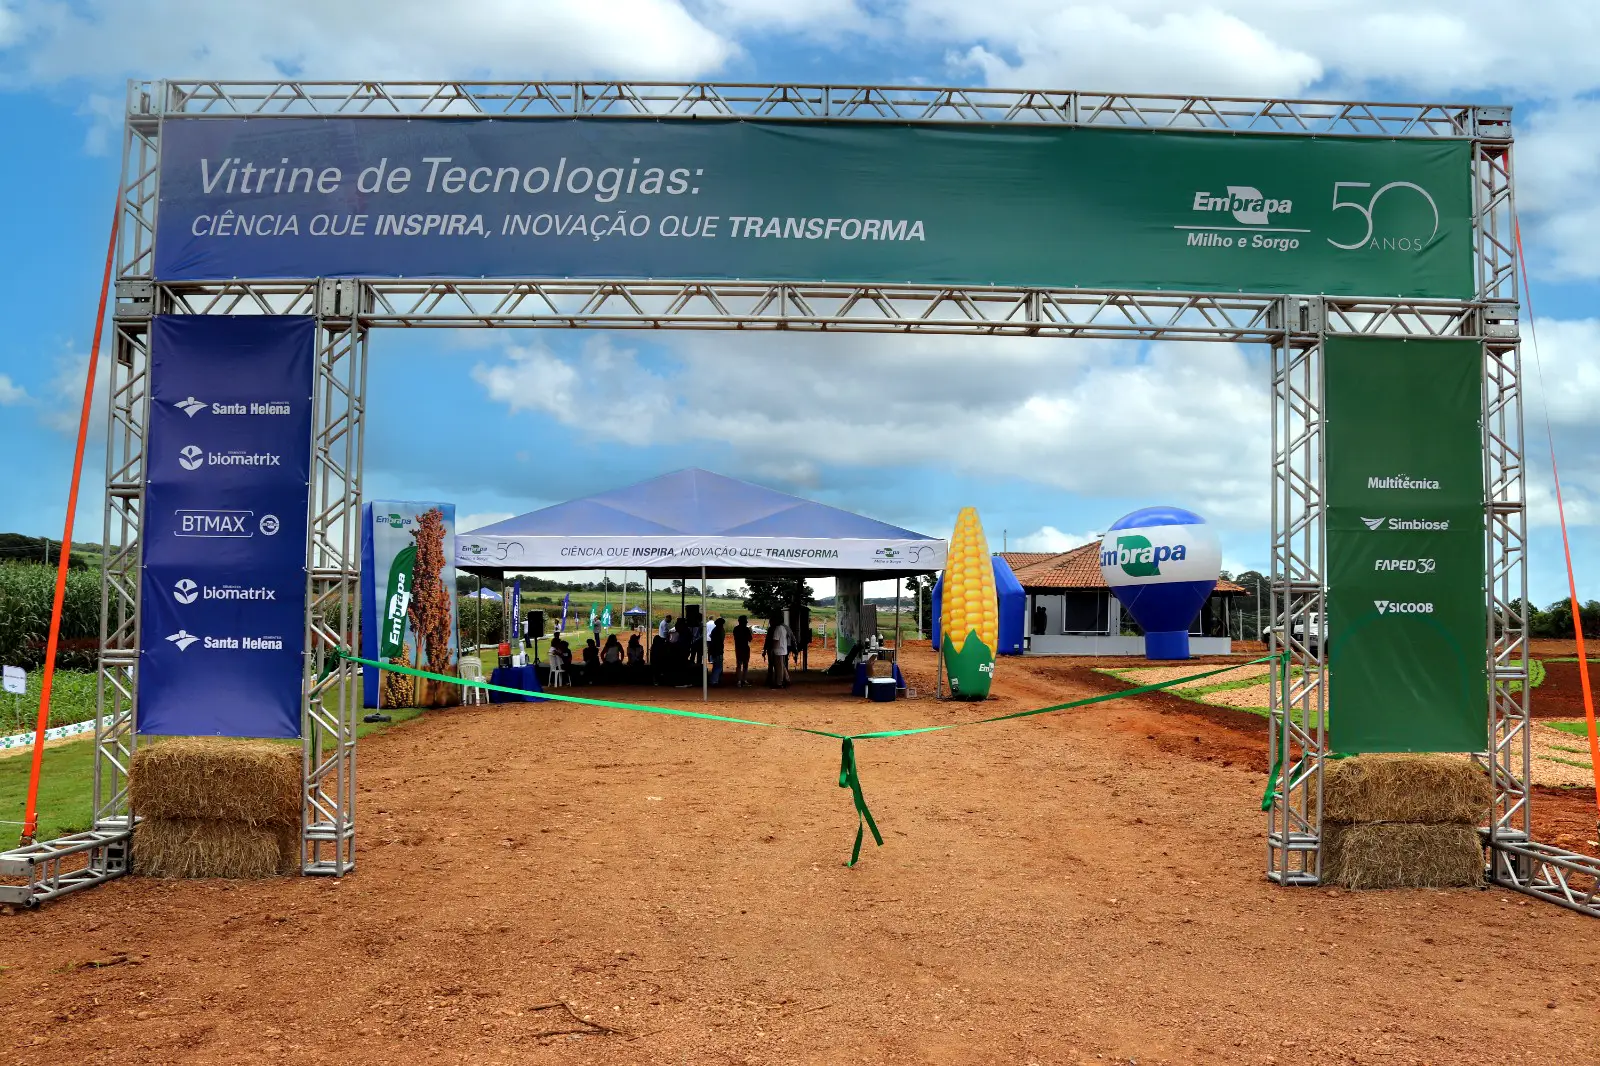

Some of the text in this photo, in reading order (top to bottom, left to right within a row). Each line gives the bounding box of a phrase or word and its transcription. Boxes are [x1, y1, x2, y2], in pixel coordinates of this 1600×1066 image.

[200, 157, 704, 203] Vitrine de Tecnologias:
[1193, 190, 1293, 214] Embrapa
[1327, 181, 1439, 250] 50
[191, 209, 926, 242] CIÊNCIA QUE INSPIRA, INOVAÇÃO QUE TRANSFORMA
[1186, 232, 1300, 252] Milho e Sorgo
[1369, 236, 1423, 251] ANOS
[212, 402, 291, 415] Santa Helena
[208, 452, 281, 466] biomatrix
[182, 514, 246, 532] BTMAX
[560, 545, 603, 557] CIÊNCIA
[607, 547, 630, 557] QUE
[680, 546, 738, 558] INOVAÇÃO
[740, 547, 763, 558] QUE
[766, 547, 839, 559] TRANSFORMA
[203, 586, 276, 600] biomatrix
[389, 572, 406, 646] Embrapa
[1389, 602, 1434, 613] SICOOB
[204, 636, 283, 650] Santa Helena
